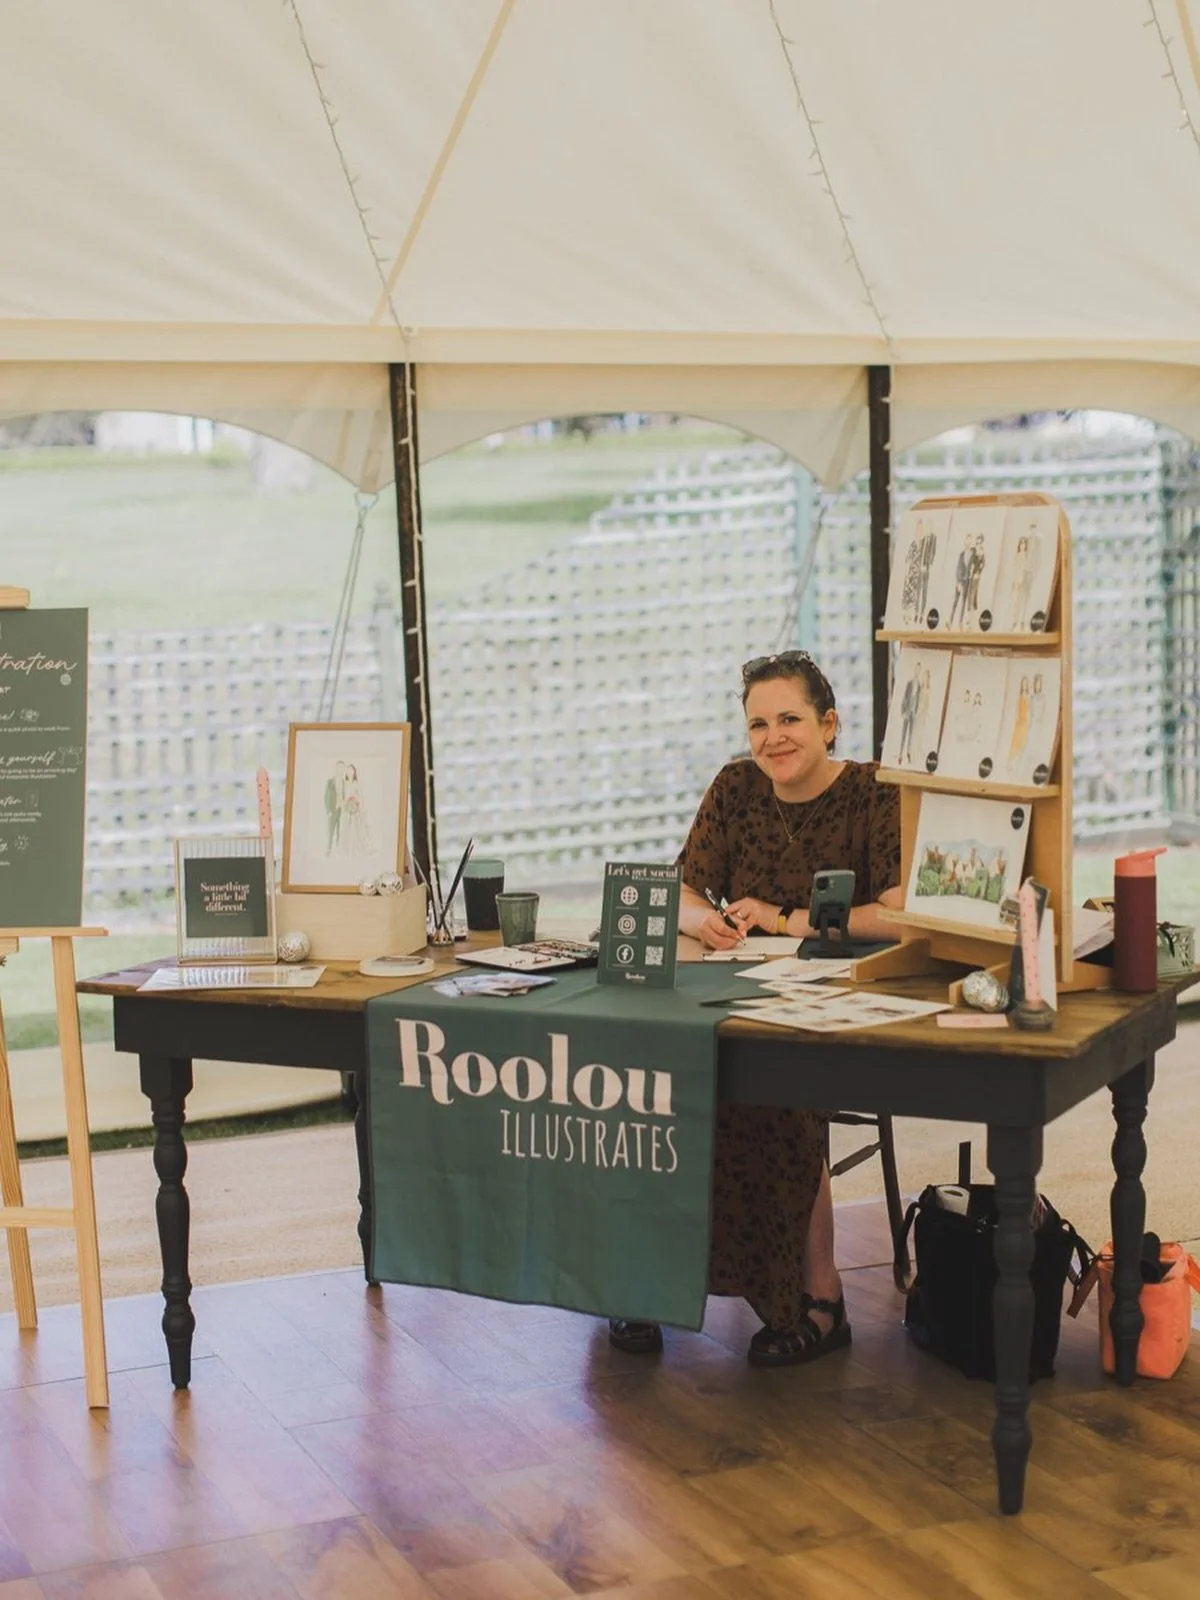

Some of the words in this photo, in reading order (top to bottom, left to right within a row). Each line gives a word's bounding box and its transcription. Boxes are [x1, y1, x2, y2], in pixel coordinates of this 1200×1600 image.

[607, 864, 630, 876] Let's
[650, 866, 678, 878] social
[200, 881, 250, 894] Something
[205, 901, 247, 912] different.
[395, 1017, 677, 1117] Roolou
[500, 1108, 678, 1173] ILLUSTRATES
